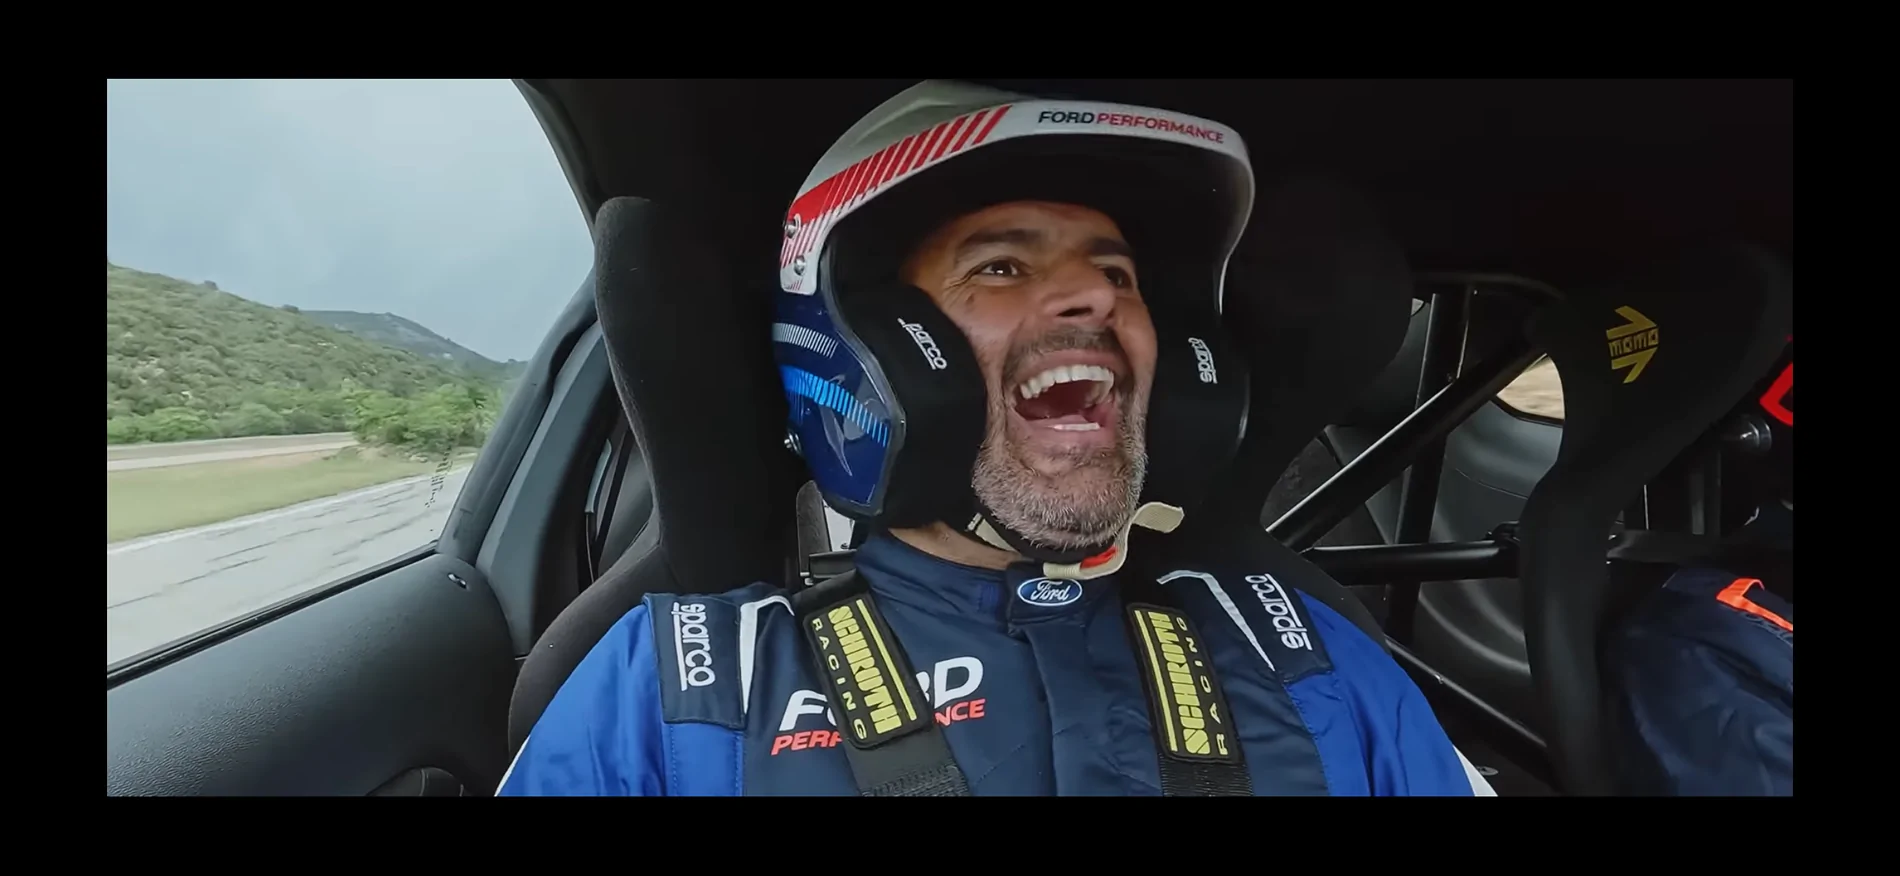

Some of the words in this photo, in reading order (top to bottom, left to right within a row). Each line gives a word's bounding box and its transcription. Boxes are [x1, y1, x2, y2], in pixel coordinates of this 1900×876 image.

[1038, 111, 1095, 124] FORD
[1096, 112, 1225, 144] PERFORMANCE
[1029, 581, 1072, 602] Ford
[1246, 574, 1312, 651] sparco
[673, 602, 716, 692] sparco
[811, 617, 869, 740] RACING
[827, 605, 902, 734] SCHROTH
[1148, 611, 1211, 755] SCHROTH
[1175, 617, 1228, 756] RACING
[779, 656, 984, 732] FD
